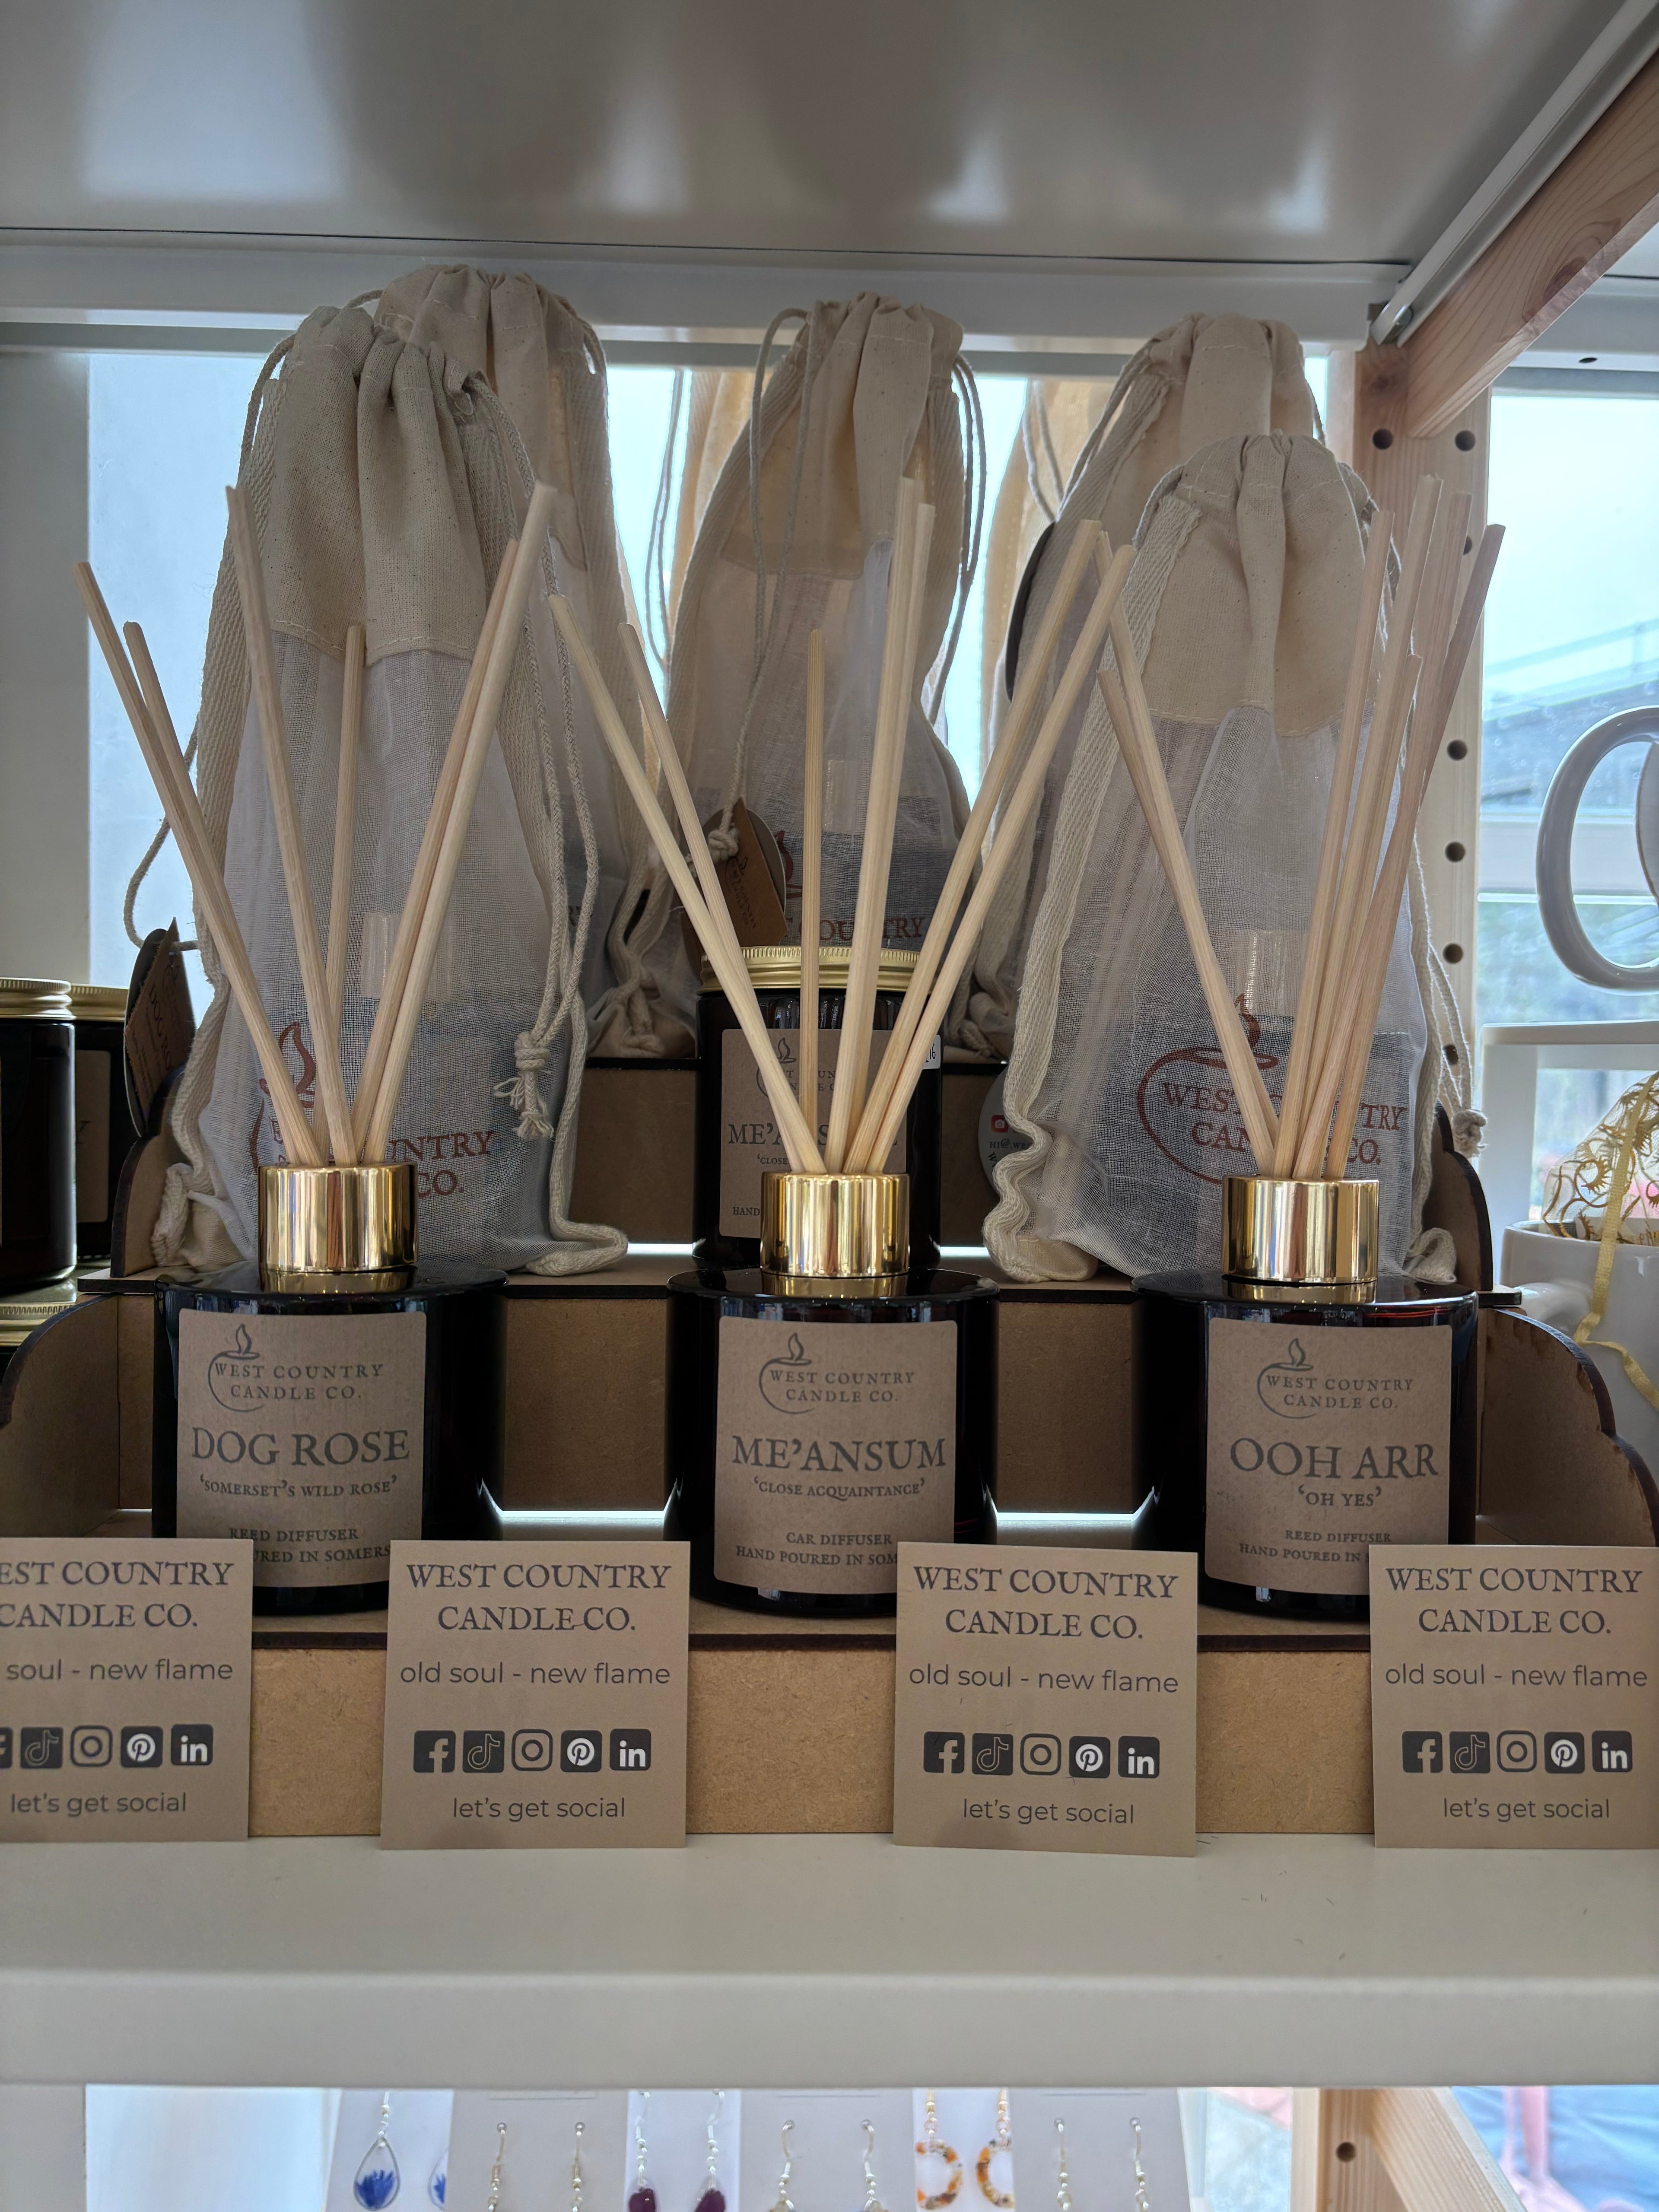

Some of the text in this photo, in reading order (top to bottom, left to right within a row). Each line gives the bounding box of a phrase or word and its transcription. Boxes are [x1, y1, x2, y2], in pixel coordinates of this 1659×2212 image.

[215, 1363, 384, 1379] WEST COUNTRY
[770, 1370, 915, 1385] WEST COUNTRY
[231, 1385, 361, 1402] CANDLE CO.
[1266, 1374, 1413, 1392] WEST COUNTRY
[786, 1389, 898, 1403] CANDLE CO.
[1284, 1394, 1398, 1409] CANDLE CO.
[191, 1427, 410, 1466] DOG ROSE
[1230, 1437, 1439, 1480] OOH ARR
[301, 1485, 344, 1497] WILD
[229, 1528, 359, 1542] REED DIFFUSER
[786, 1532, 892, 1545] CAR DIFFUSER
[1285, 1530, 1391, 1543] REED DIFFUSER
[299, 1551, 319, 1563] IN
[736, 1545, 775, 1560] HAND
[779, 1551, 841, 1566] POURED
[845, 1554, 864, 1566] IN
[1239, 1543, 1278, 1557] HAND
[1282, 1548, 1341, 1562] POURED
[1345, 1552, 1360, 1562] IN
[62, 1561, 234, 1586] COUNTRY
[406, 1564, 672, 1589] WEST COUNTRY
[913, 1566, 1179, 1598] WEST COUNTRY
[1386, 1567, 1643, 1593] WEST COUNTRY
[144, 1603, 197, 1627] CO.
[438, 1606, 636, 1630] CANDLE CO.
[945, 1609, 1143, 1639] CANDLE CO.
[1418, 1609, 1611, 1634] CANDLE CO.
[6, 1659, 62, 1681] soul
[90, 1664, 148, 1680] new
[155, 1658, 233, 1680] flame
[400, 1661, 441, 1683] old
[449, 1662, 503, 1683] soul
[531, 1668, 587, 1684] new
[594, 1662, 670, 1684] flame
[909, 1663, 949, 1685] old
[958, 1666, 1011, 1687] soul
[1039, 1673, 1095, 1690] new
[1101, 1669, 1179, 1693] flame
[1386, 1663, 1424, 1684] old
[1433, 1664, 1484, 1685] soul
[1512, 1670, 1566, 1686] new
[1573, 1665, 1648, 1687] flame
[67, 1795, 109, 1818] get
[117, 1792, 186, 1813] social
[508, 1800, 550, 1822] get
[556, 1797, 625, 1818] social
[1017, 1803, 1058, 1825] get
[1066, 1803, 1134, 1824] social
[1497, 1800, 1537, 1823] get
[1543, 1798, 1609, 1818] social
